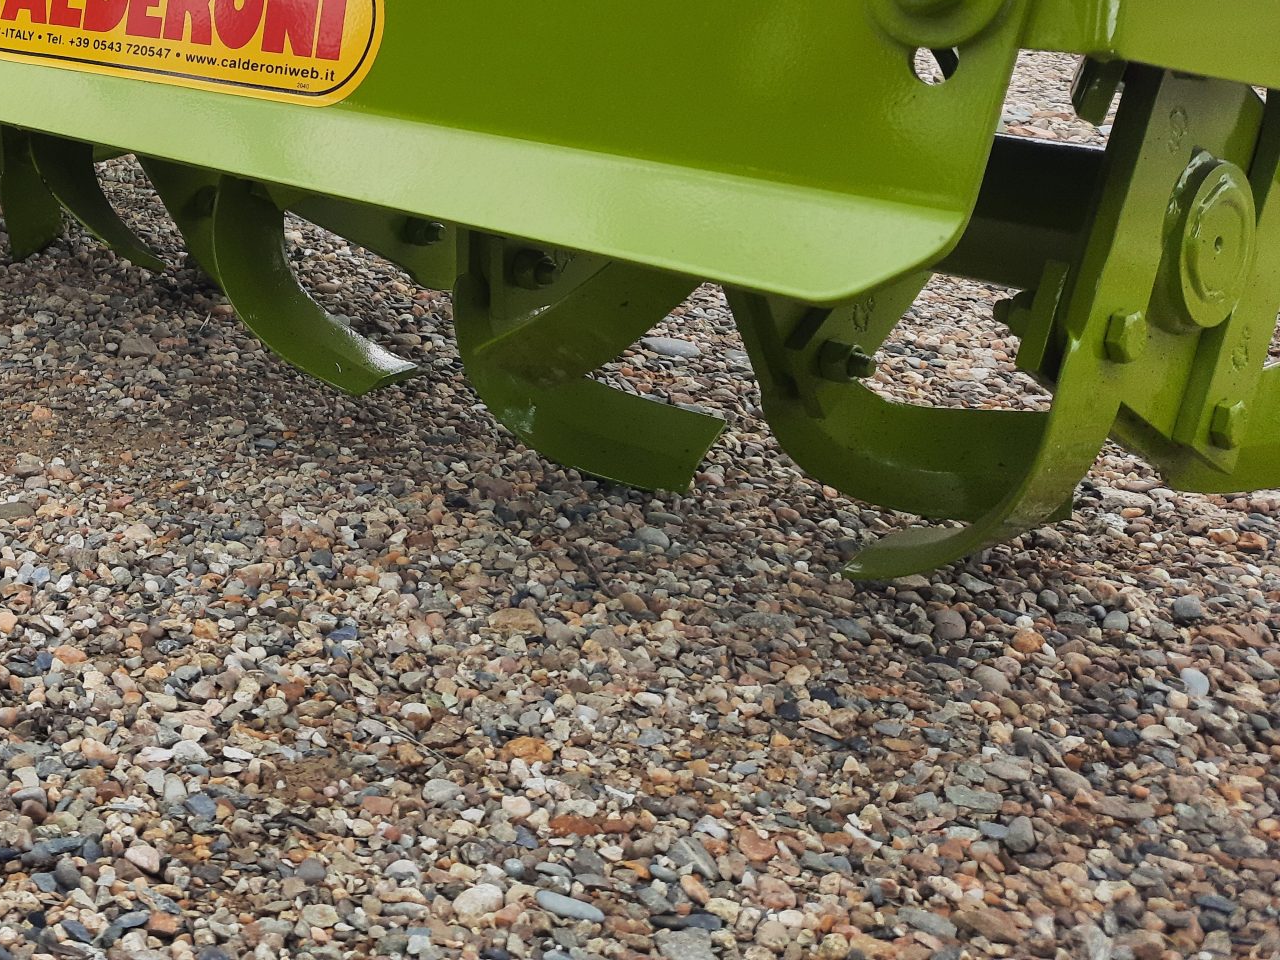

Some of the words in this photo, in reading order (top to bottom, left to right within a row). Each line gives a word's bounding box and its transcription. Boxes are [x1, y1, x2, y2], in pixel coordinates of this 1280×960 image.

[46, 33, 65, 45] Tel.
[69, 37, 90, 48] +39
[93, 39, 122, 52] 0543
[126, 43, 171, 59] 720547
[185, 52, 335, 82] www.calderoniweb.it
